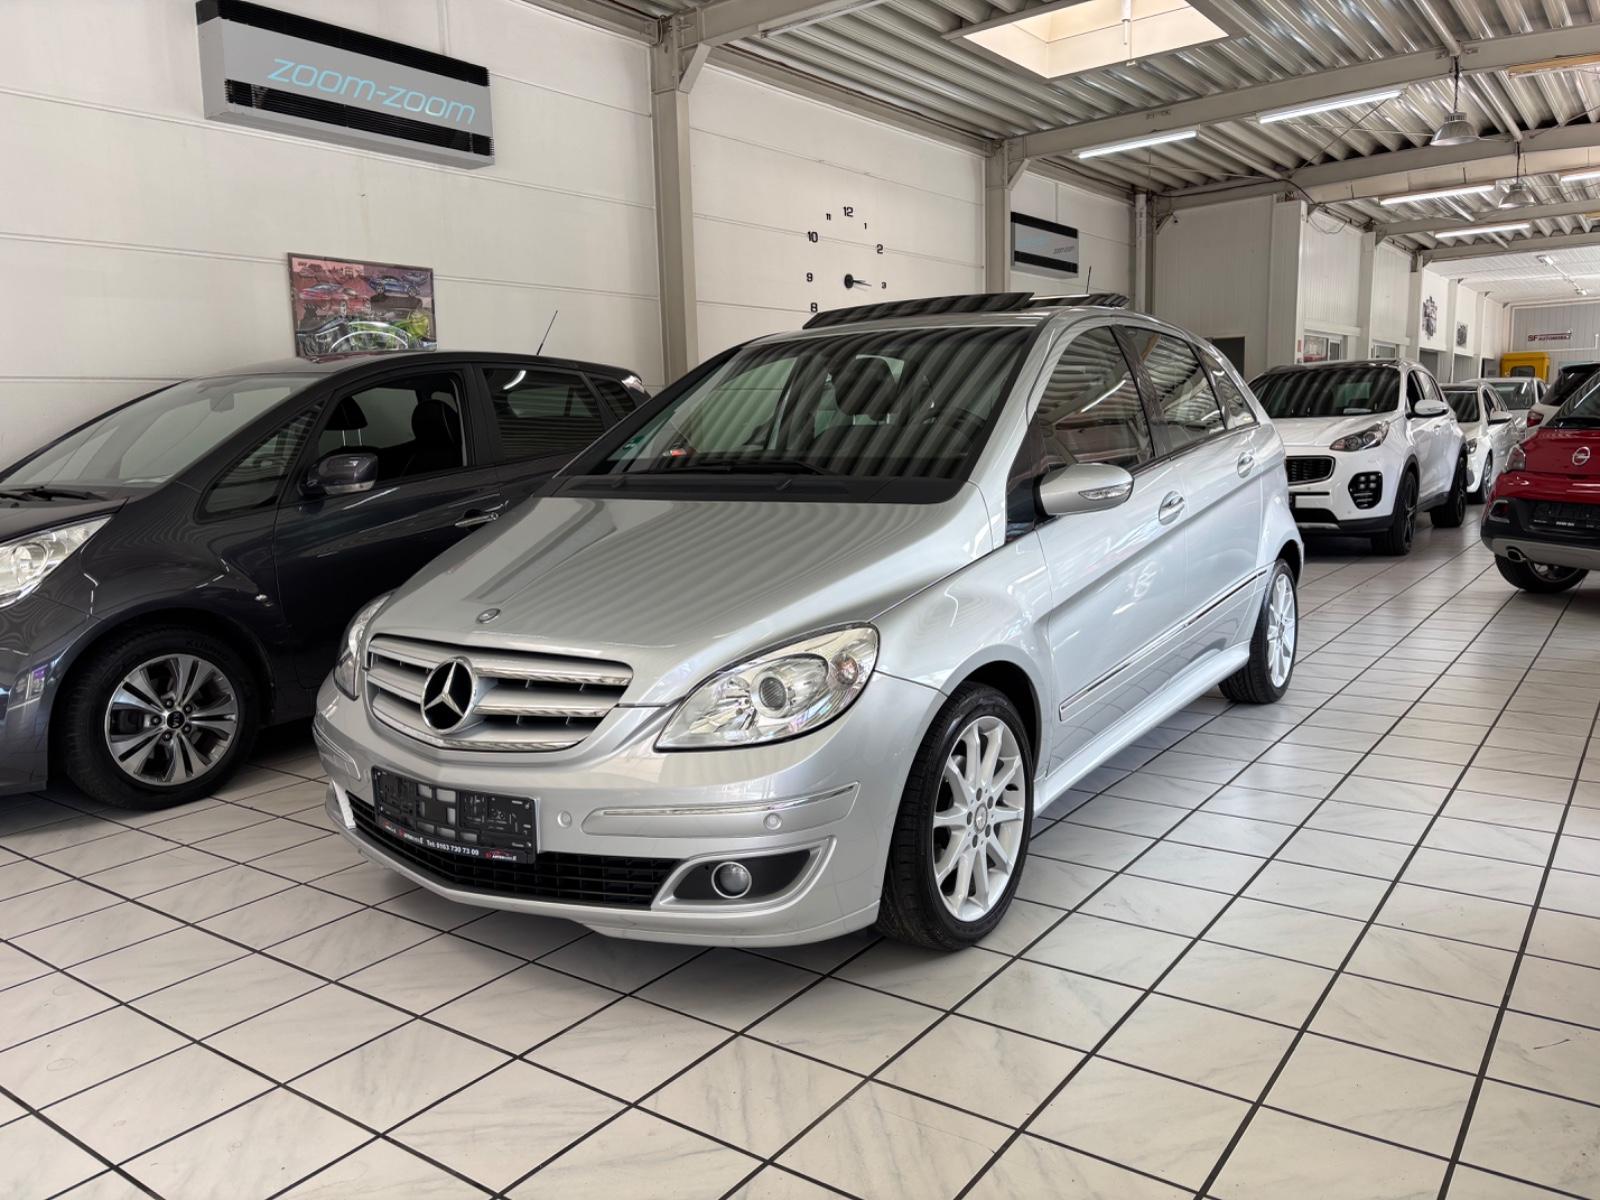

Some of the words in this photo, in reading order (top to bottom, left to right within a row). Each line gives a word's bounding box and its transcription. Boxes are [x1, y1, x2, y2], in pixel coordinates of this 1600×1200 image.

[267, 57, 476, 125] zoom-zoom
[843, 206, 854, 218] 12
[808, 231, 818, 243] 10
[876, 244, 884, 254] 2
[806, 272, 814, 283] 9
[882, 282, 887, 290] 3
[810, 302, 818, 313] 8
